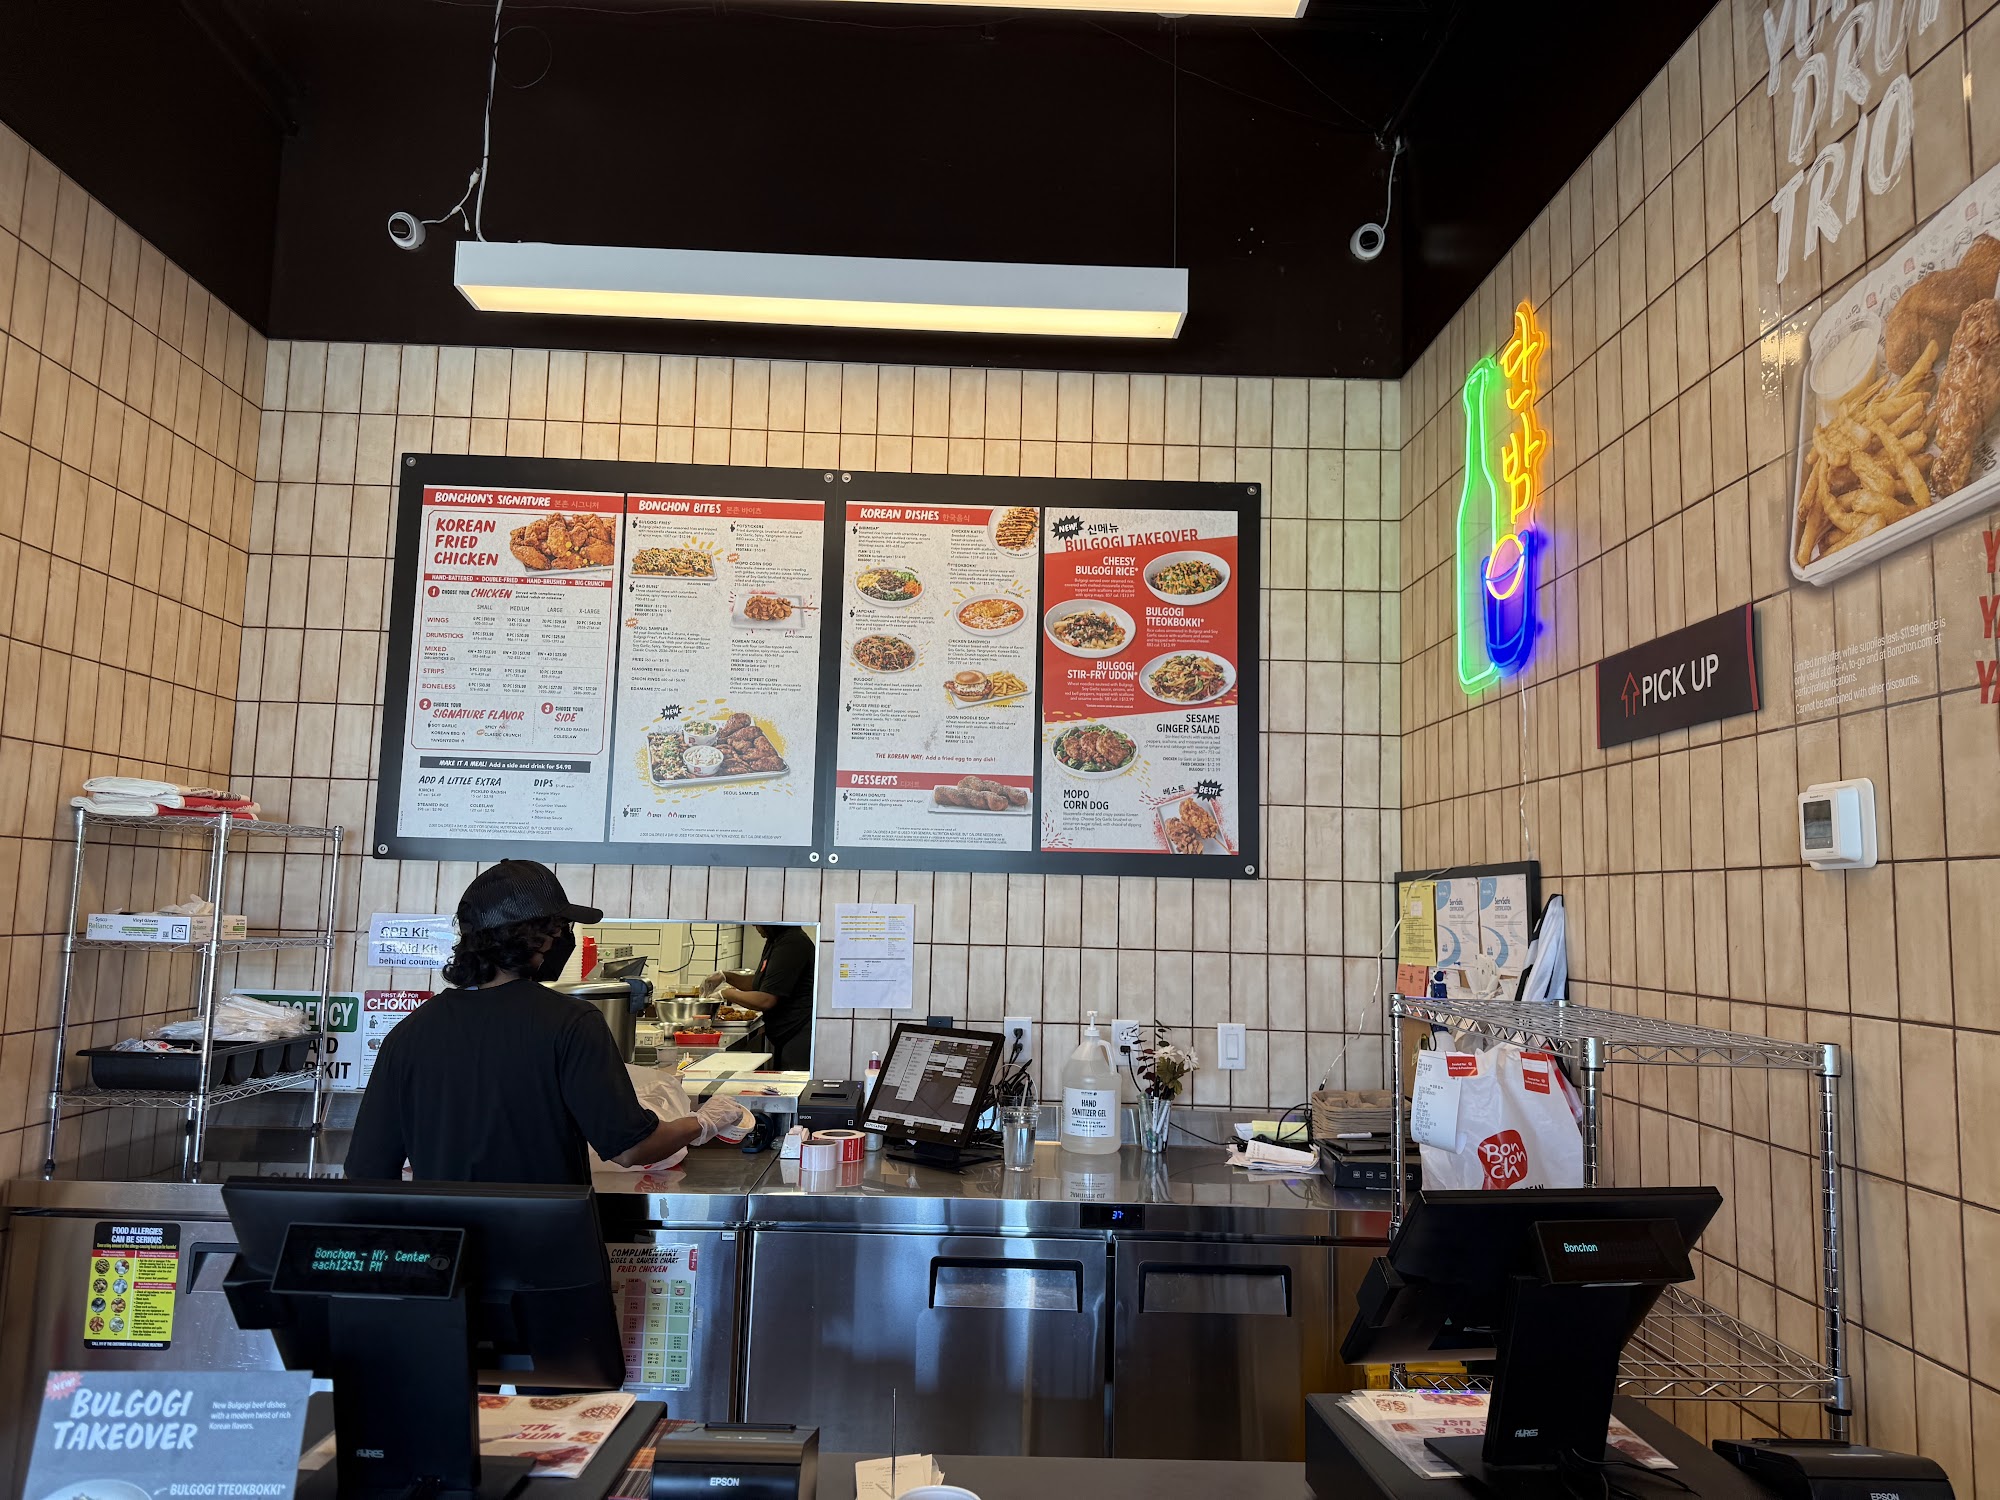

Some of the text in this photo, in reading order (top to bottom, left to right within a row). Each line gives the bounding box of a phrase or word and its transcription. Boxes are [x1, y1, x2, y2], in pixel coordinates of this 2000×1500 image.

[1763, 0, 1847, 97] YU
[1771, 73, 1915, 285] TRIO
[434, 491, 551, 507] BONCHON'S SIGNATURE
[638, 500, 722, 514] BONCHON BITES
[860, 508, 940, 521] KOREAN DISHES
[942, 513, 970, 523] 한국음식
[436, 518, 496, 533] KOREAN
[1058, 522, 1078, 533] NEW!
[1087, 523, 1119, 535] 신메뉴
[435, 534, 478, 548] FRIED
[1065, 528, 1199, 553] BULGOGI TAKEOVER
[434, 552, 499, 566] CHICKEN
[1103, 556, 1135, 566] CHEESY
[1075, 566, 1114, 575] BULGOGI
[471, 588, 512, 598] CHICKEN
[1146, 607, 1184, 617] BULGOGI
[1794, 620, 1938, 673] Limited while supplies $11.99 price
[1849, 637, 1933, 670] to-go and Bonchon.com
[1096, 661, 1135, 670] BULGOGI
[1067, 670, 1106, 679] STIR-FRY
[1642, 653, 1719, 707] PICK UP
[1796, 672, 1857, 698] participating locations.
[1796, 674, 1920, 715] Cannot combined with other discounts.
[433, 709, 525, 721] SIGNATURE FLAVOR
[664, 707, 679, 716] NEW
[555, 713, 577, 722] SIDE
[1186, 714, 1220, 723] SESAME
[1156, 724, 1220, 734] GINGER SALAD
[419, 775, 502, 786] ADD A LITTLE EXTRA
[534, 779, 554, 787] DIPS
[851, 774, 898, 786] DESSERTS
[1063, 790, 1089, 798] MOPO
[1162, 784, 1186, 795] 베스트
[1198, 785, 1219, 795] BEST!
[1063, 800, 1109, 810] CORN DOG
[381, 927, 429, 937] CPR Kit
[380, 943, 396, 952] 1st
[400, 943, 419, 952] Aid
[323, 1062, 351, 1079] KIT
[1081, 1099, 1097, 1107] HAND
[1072, 1108, 1106, 1117] SANITIZER GEL
[112, 1227, 163, 1235] FOOD ALLERGIES
[112, 1235, 126, 1243] CAN
[135, 1236, 163, 1244] SERIOUS
[611, 1248, 679, 1257] COMPLIMENTARY
[1564, 1242, 1598, 1253] Bonchon
[315, 1248, 431, 1263] Bonchon NY, Center
[312, 1260, 383, 1272] each12:31 PM
[617, 1265, 636, 1273] FRIED
[52, 1376, 77, 1392] NEW!
[69, 1388, 194, 1419] BULGOGI
[213, 1401, 286, 1411] New Bulgogi beef dishes
[231, 1412, 254, 1420] modern
[209, 1422, 254, 1430] Korean flavors.
[53, 1421, 198, 1450] TAKEOVER
[710, 1477, 740, 1488] EPSON
[169, 1484, 216, 1496] BULGOGI
